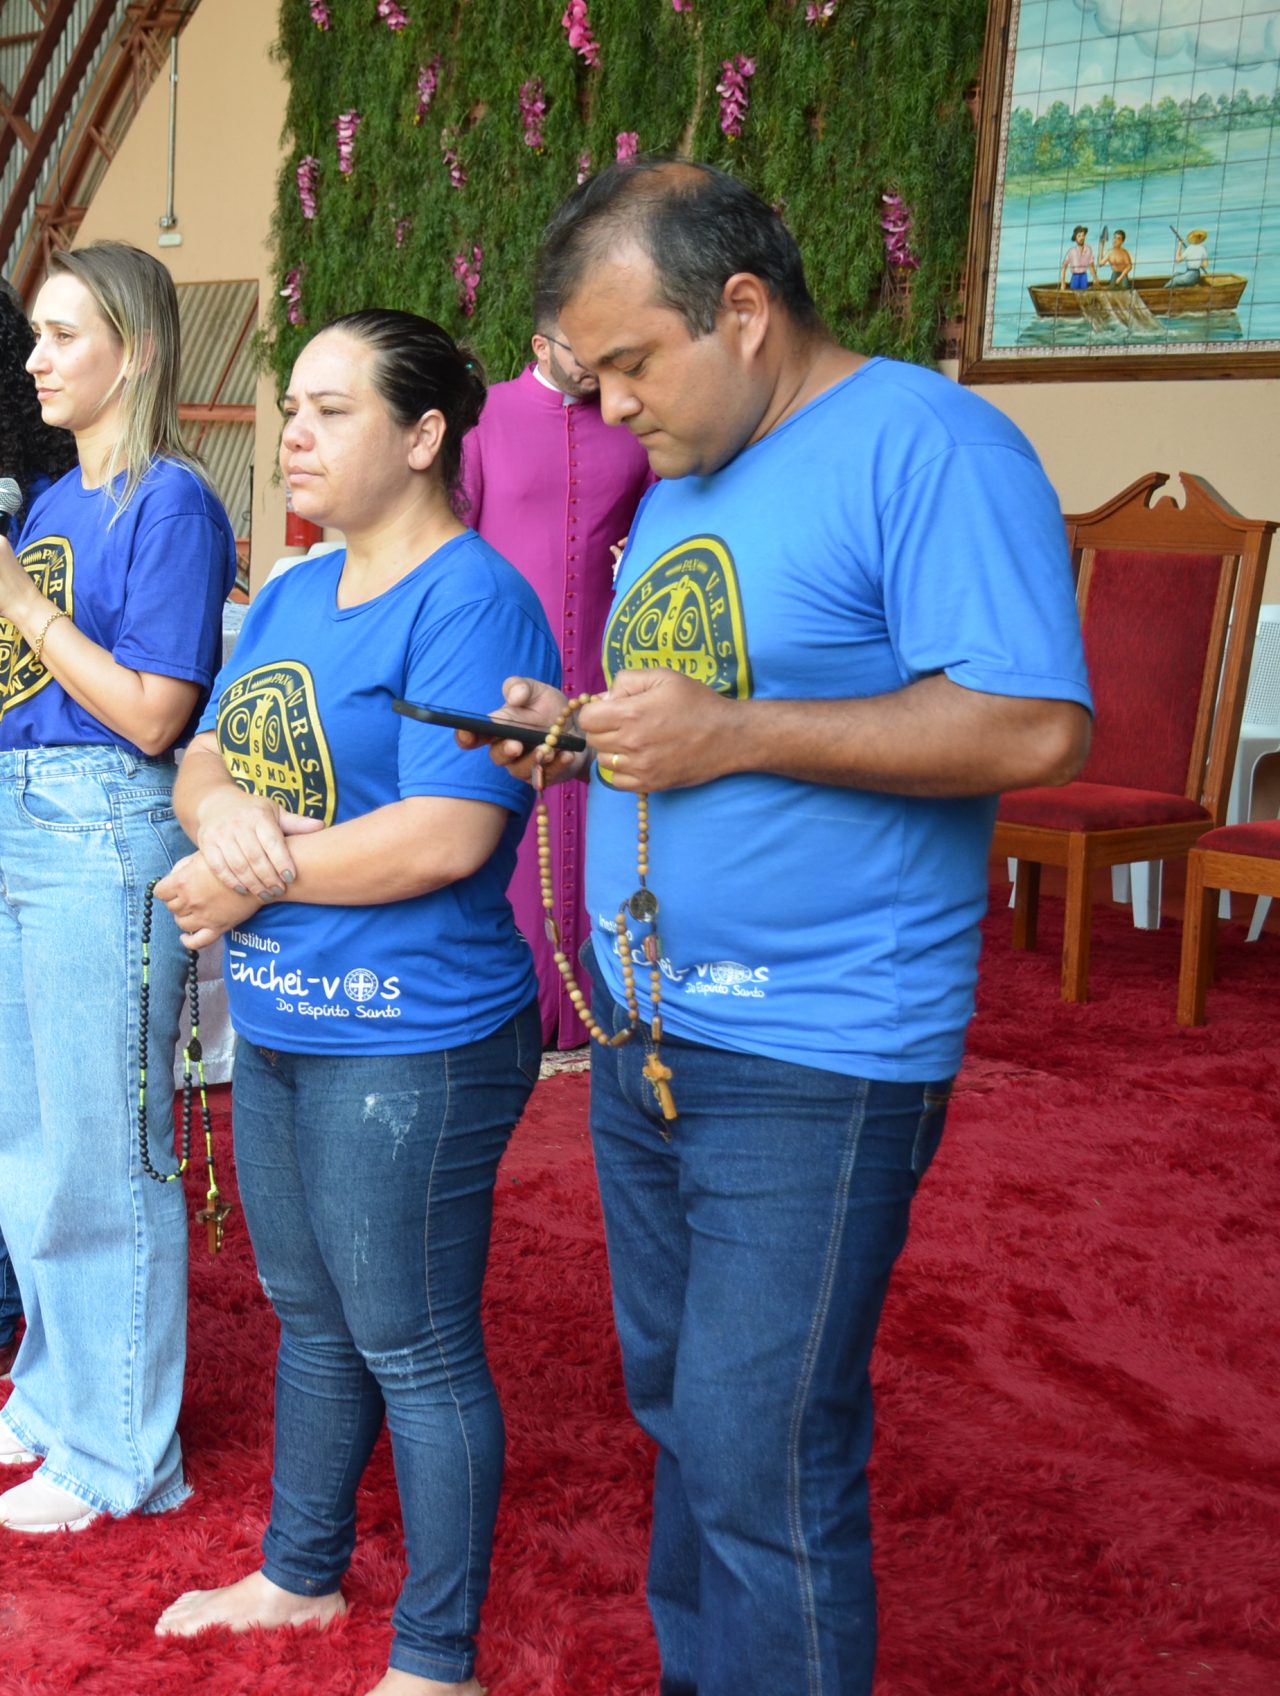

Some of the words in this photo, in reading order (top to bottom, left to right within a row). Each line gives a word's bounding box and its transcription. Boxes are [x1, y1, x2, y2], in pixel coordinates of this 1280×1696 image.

[231, 928, 281, 954] Instituto
[731, 984, 765, 998] Santo
[276, 997, 293, 1013] Do
[298, 1001, 350, 1020] Espírito
[355, 1005, 401, 1019] Santo
